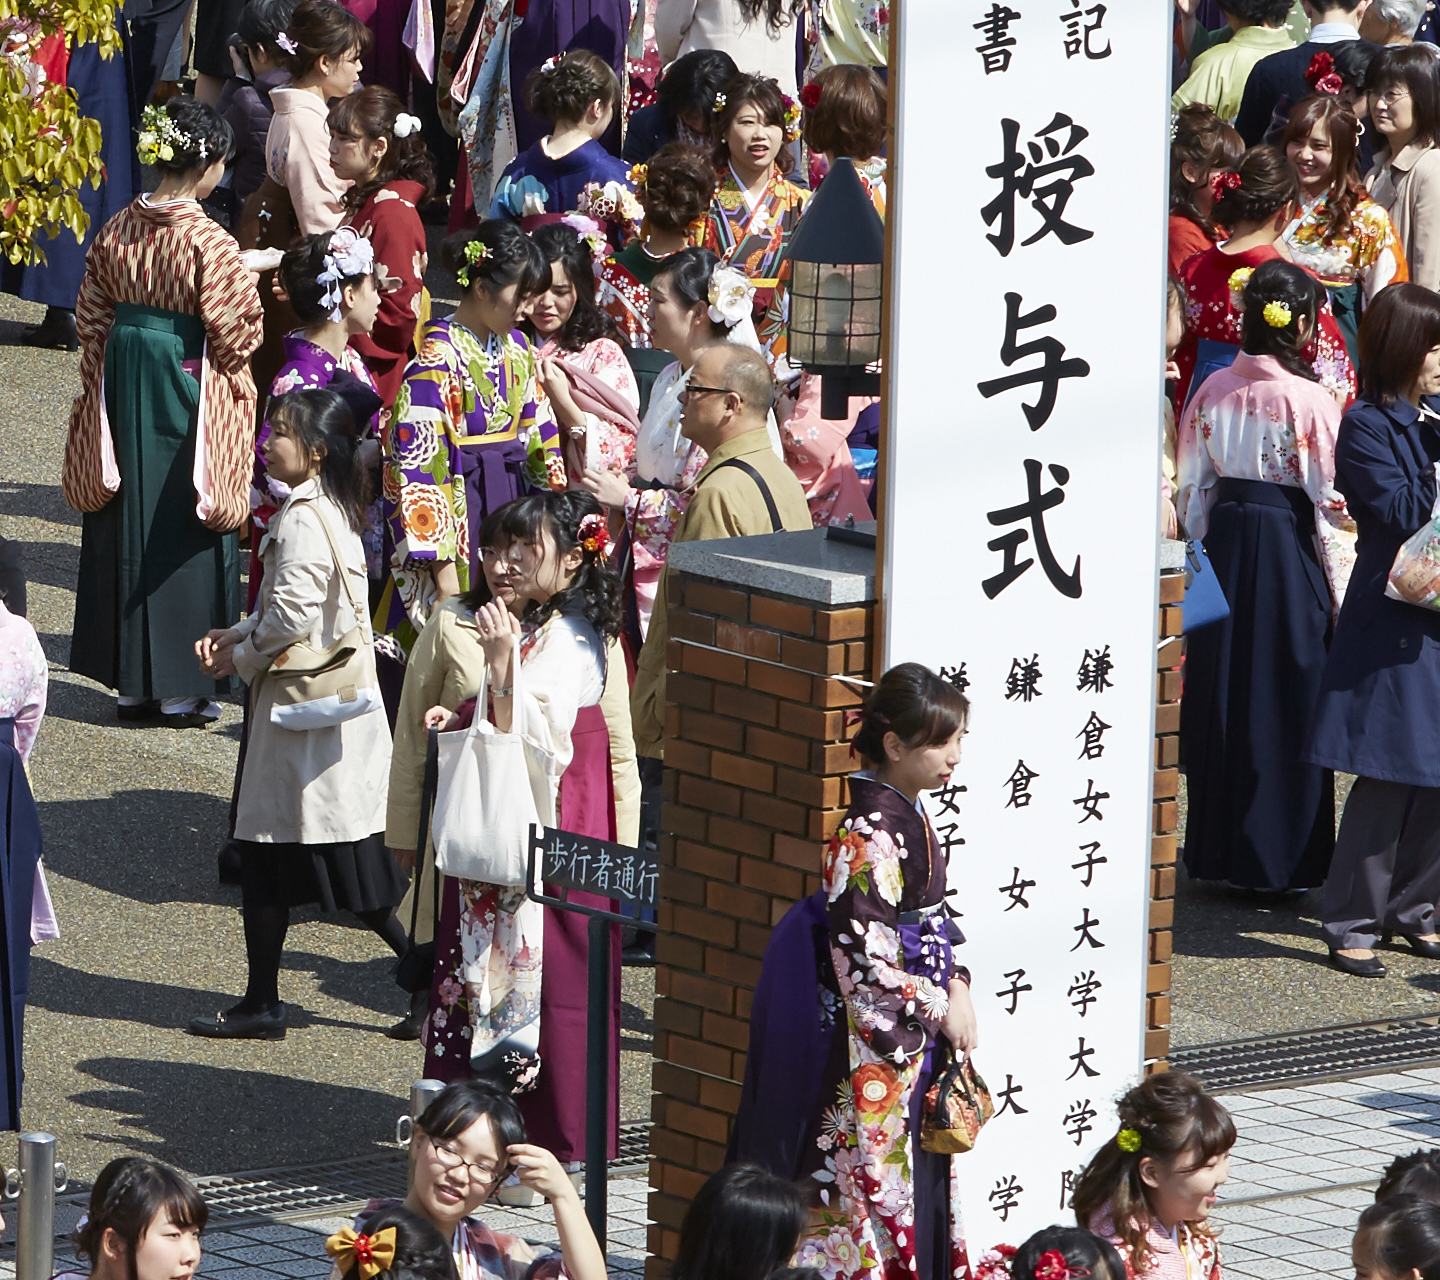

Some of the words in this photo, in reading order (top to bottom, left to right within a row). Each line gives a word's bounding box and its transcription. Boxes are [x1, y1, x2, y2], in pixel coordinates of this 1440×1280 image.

[977, 112, 1096, 601] 授与式
[546, 837, 660, 904] 歩行者通行
[988, 652, 1044, 1222] 鎌倉女子大学
